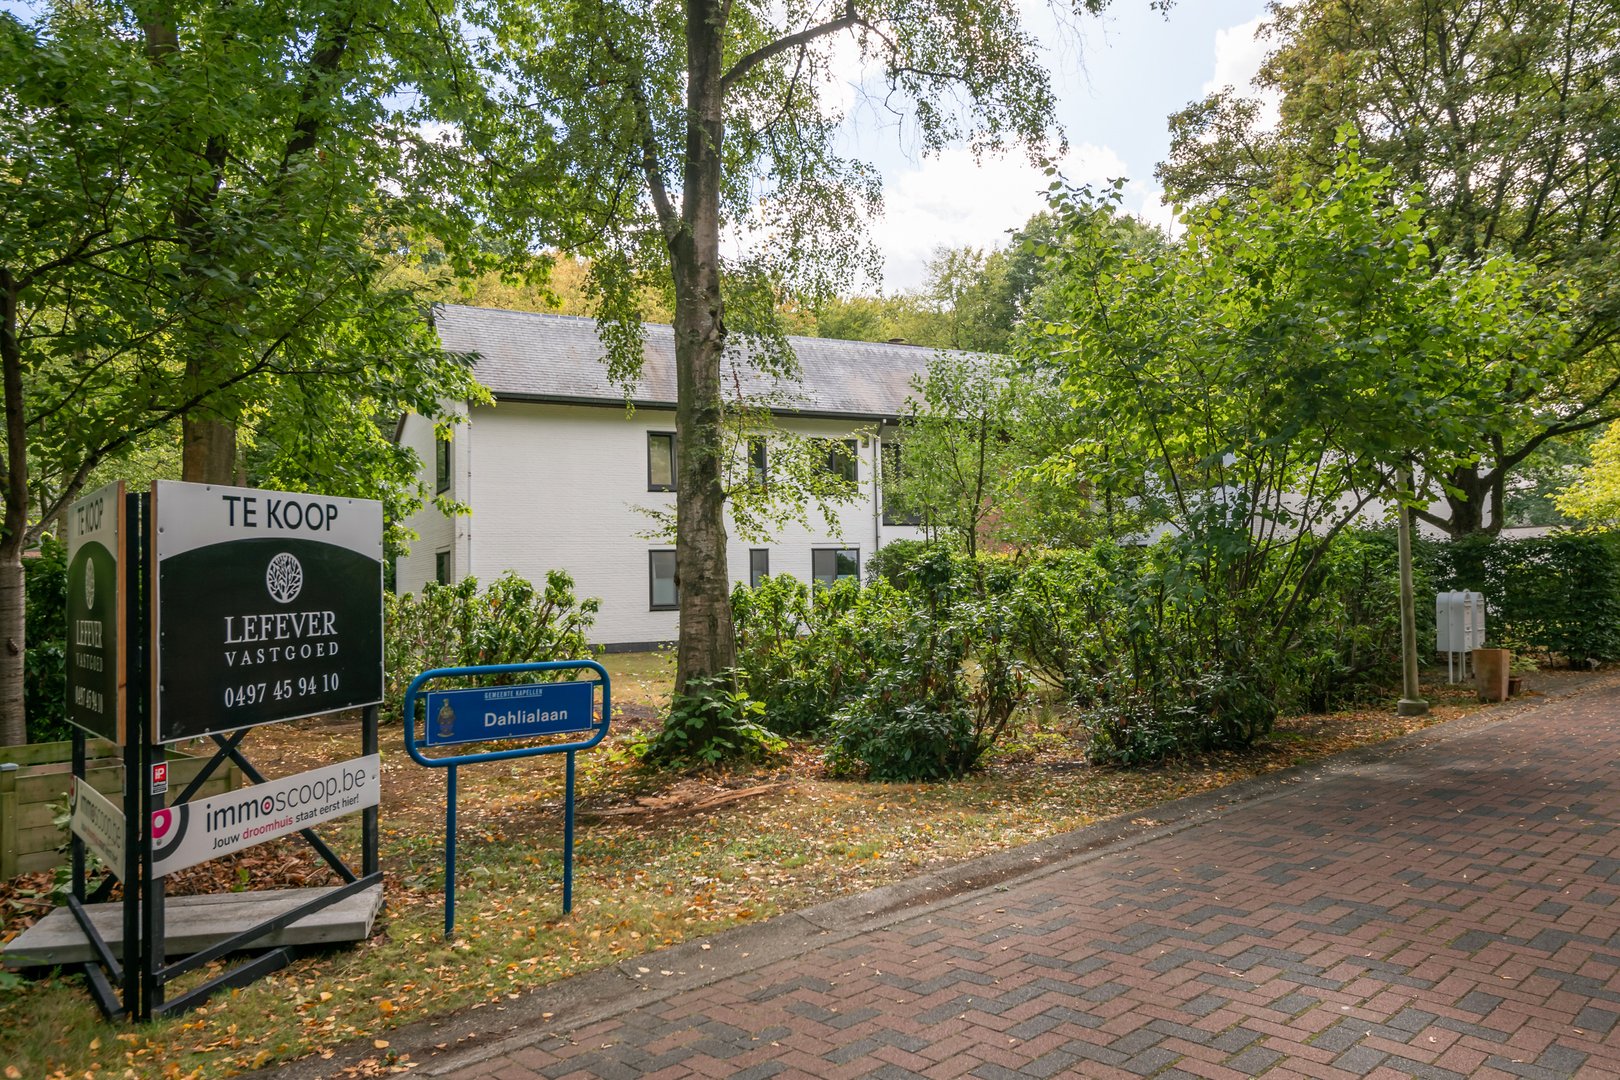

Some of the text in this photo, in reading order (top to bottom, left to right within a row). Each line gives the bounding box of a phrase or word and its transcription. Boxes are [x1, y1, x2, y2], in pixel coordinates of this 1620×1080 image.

[222, 495, 338, 531] TE KOOP
[224, 611, 338, 644] LEFEVER
[224, 641, 338, 667] VASTGOED
[224, 672, 339, 708] 0497 45 94 10
[484, 688, 543, 699] GEMEENTE KAPELLEN
[484, 708, 568, 727] Dahlialaan
[206, 768, 366, 833] immoscoop.be
[213, 793, 360, 850] Jouw droomhuis staat eerst hier!
